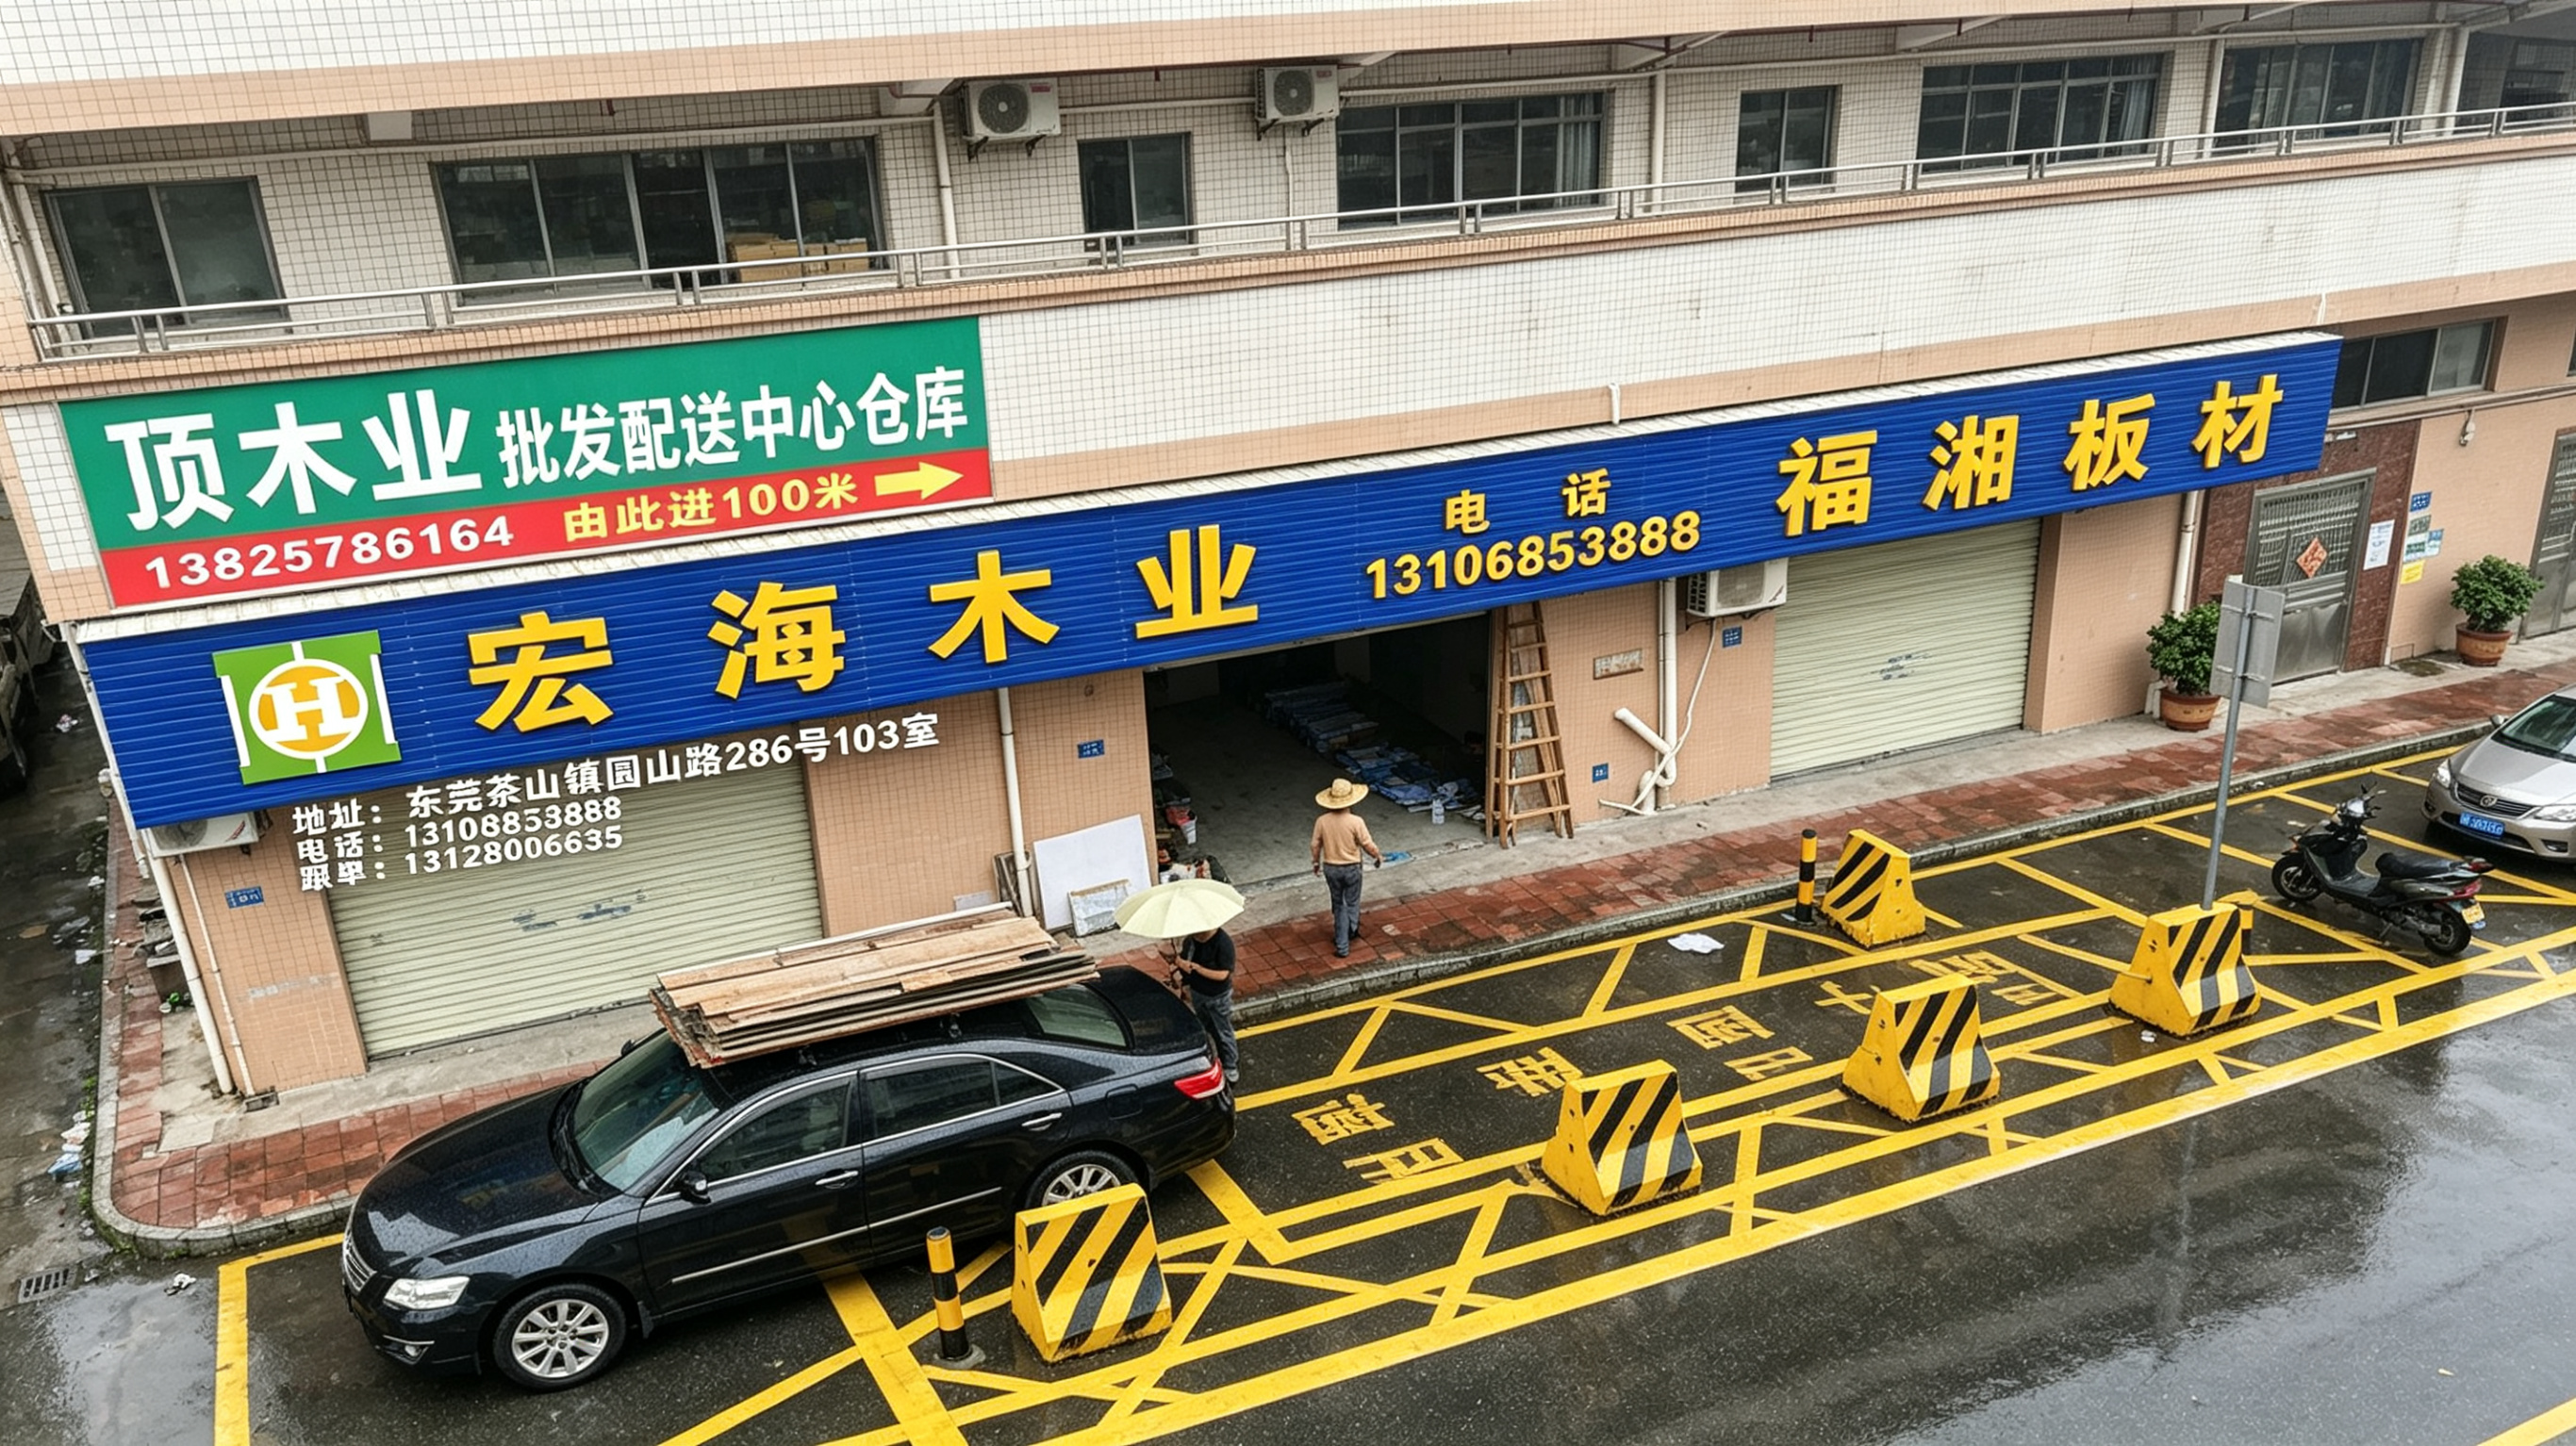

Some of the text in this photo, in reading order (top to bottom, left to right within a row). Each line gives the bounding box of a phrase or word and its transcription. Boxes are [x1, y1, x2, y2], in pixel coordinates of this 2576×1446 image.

[105, 366, 967, 531] 顶木业 批发配送中心仓库
[1776, 374, 2284, 537] 福湘板材
[145, 472, 858, 588] 13825786164 由此进100米
[1445, 468, 1611, 534] 电话
[1366, 510, 1700, 599] 13106853888
[468, 524, 1259, 732] 宏海木业
[405, 796, 621, 847] 13108853888
[405, 825, 622, 875] 13128006635
